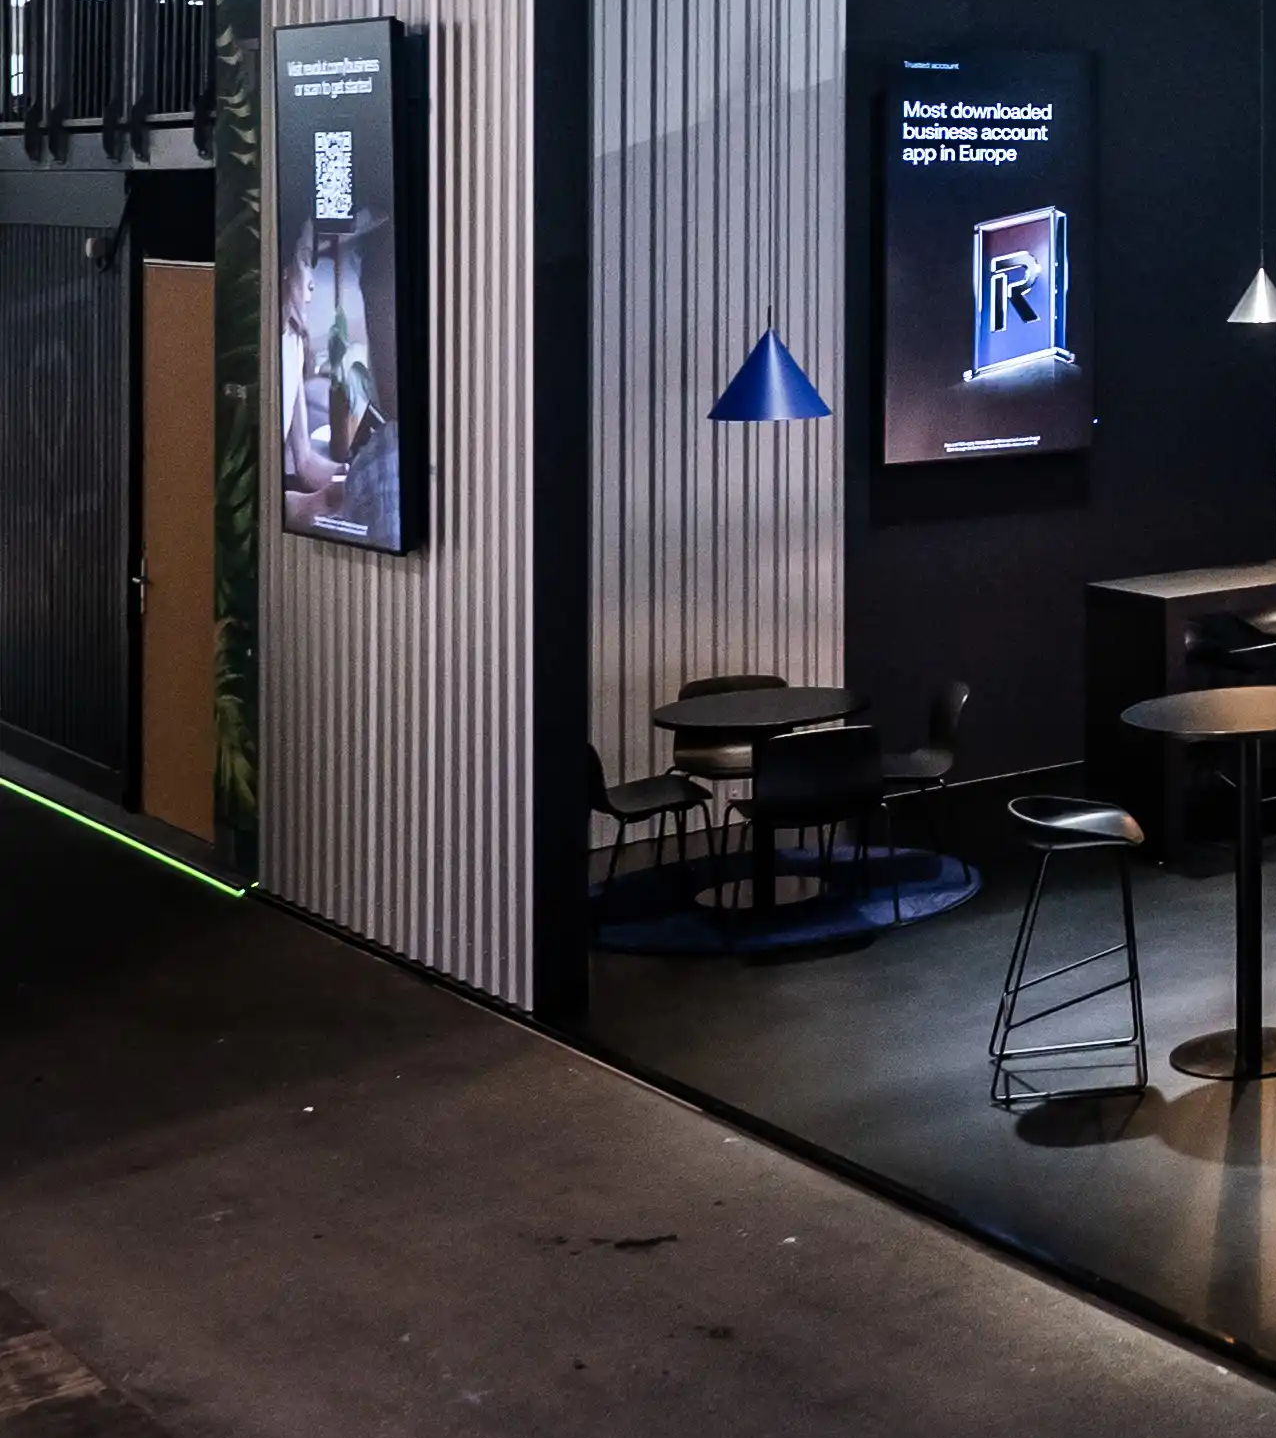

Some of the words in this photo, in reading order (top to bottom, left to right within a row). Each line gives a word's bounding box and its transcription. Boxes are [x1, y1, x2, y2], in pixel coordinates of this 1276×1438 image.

[903, 100, 948, 119] Most
[950, 101, 1053, 121] downloaded
[902, 122, 979, 141] business
[980, 124, 1049, 141] account
[902, 147, 938, 166] app
[939, 143, 956, 162] in
[958, 144, 1018, 166] Europe
